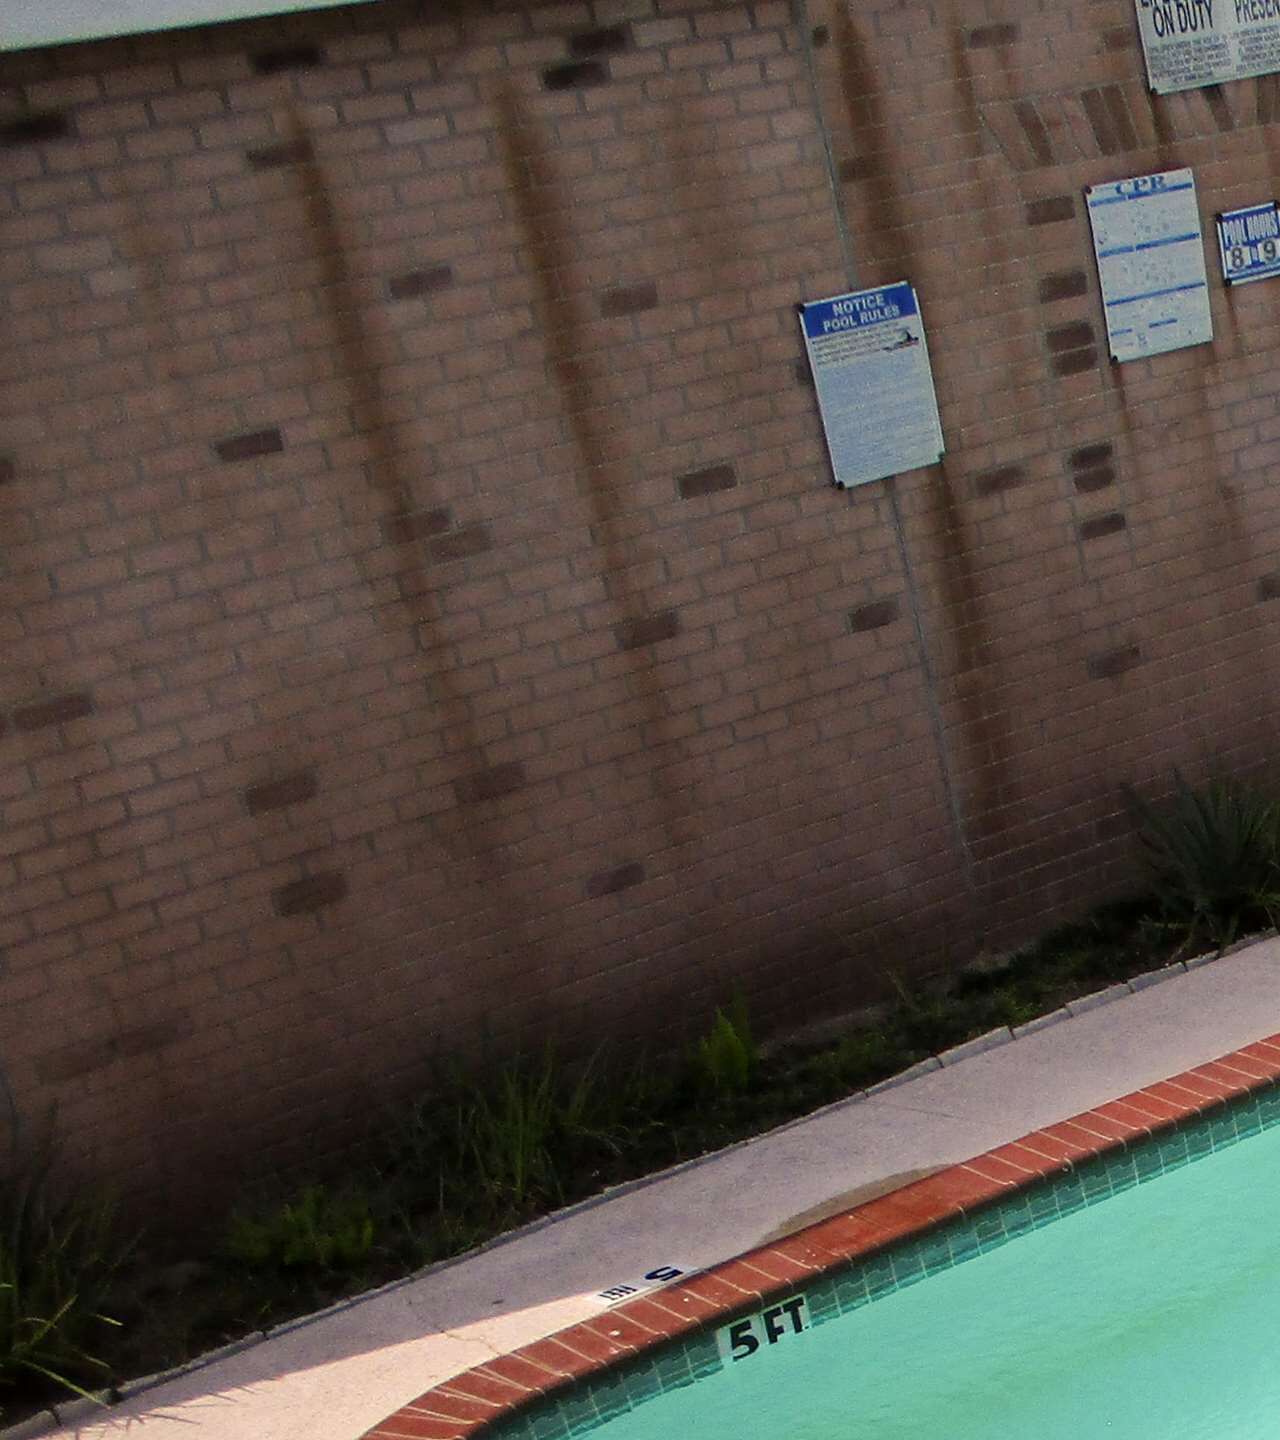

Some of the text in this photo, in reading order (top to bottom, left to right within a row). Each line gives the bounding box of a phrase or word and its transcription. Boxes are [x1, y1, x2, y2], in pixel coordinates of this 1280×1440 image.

[1153, 0, 1213, 37] ON DUTY
[1115, 176, 1168, 194] CPR
[1222, 210, 1278, 246] POOL HOURS
[1231, 246, 1244, 269] 8
[1263, 240, 1276, 261] 9
[823, 304, 900, 333] POOL RULES
[832, 293, 886, 317] NOTICE
[645, 1266, 684, 1281] 5
[729, 1318, 760, 1362] 5
